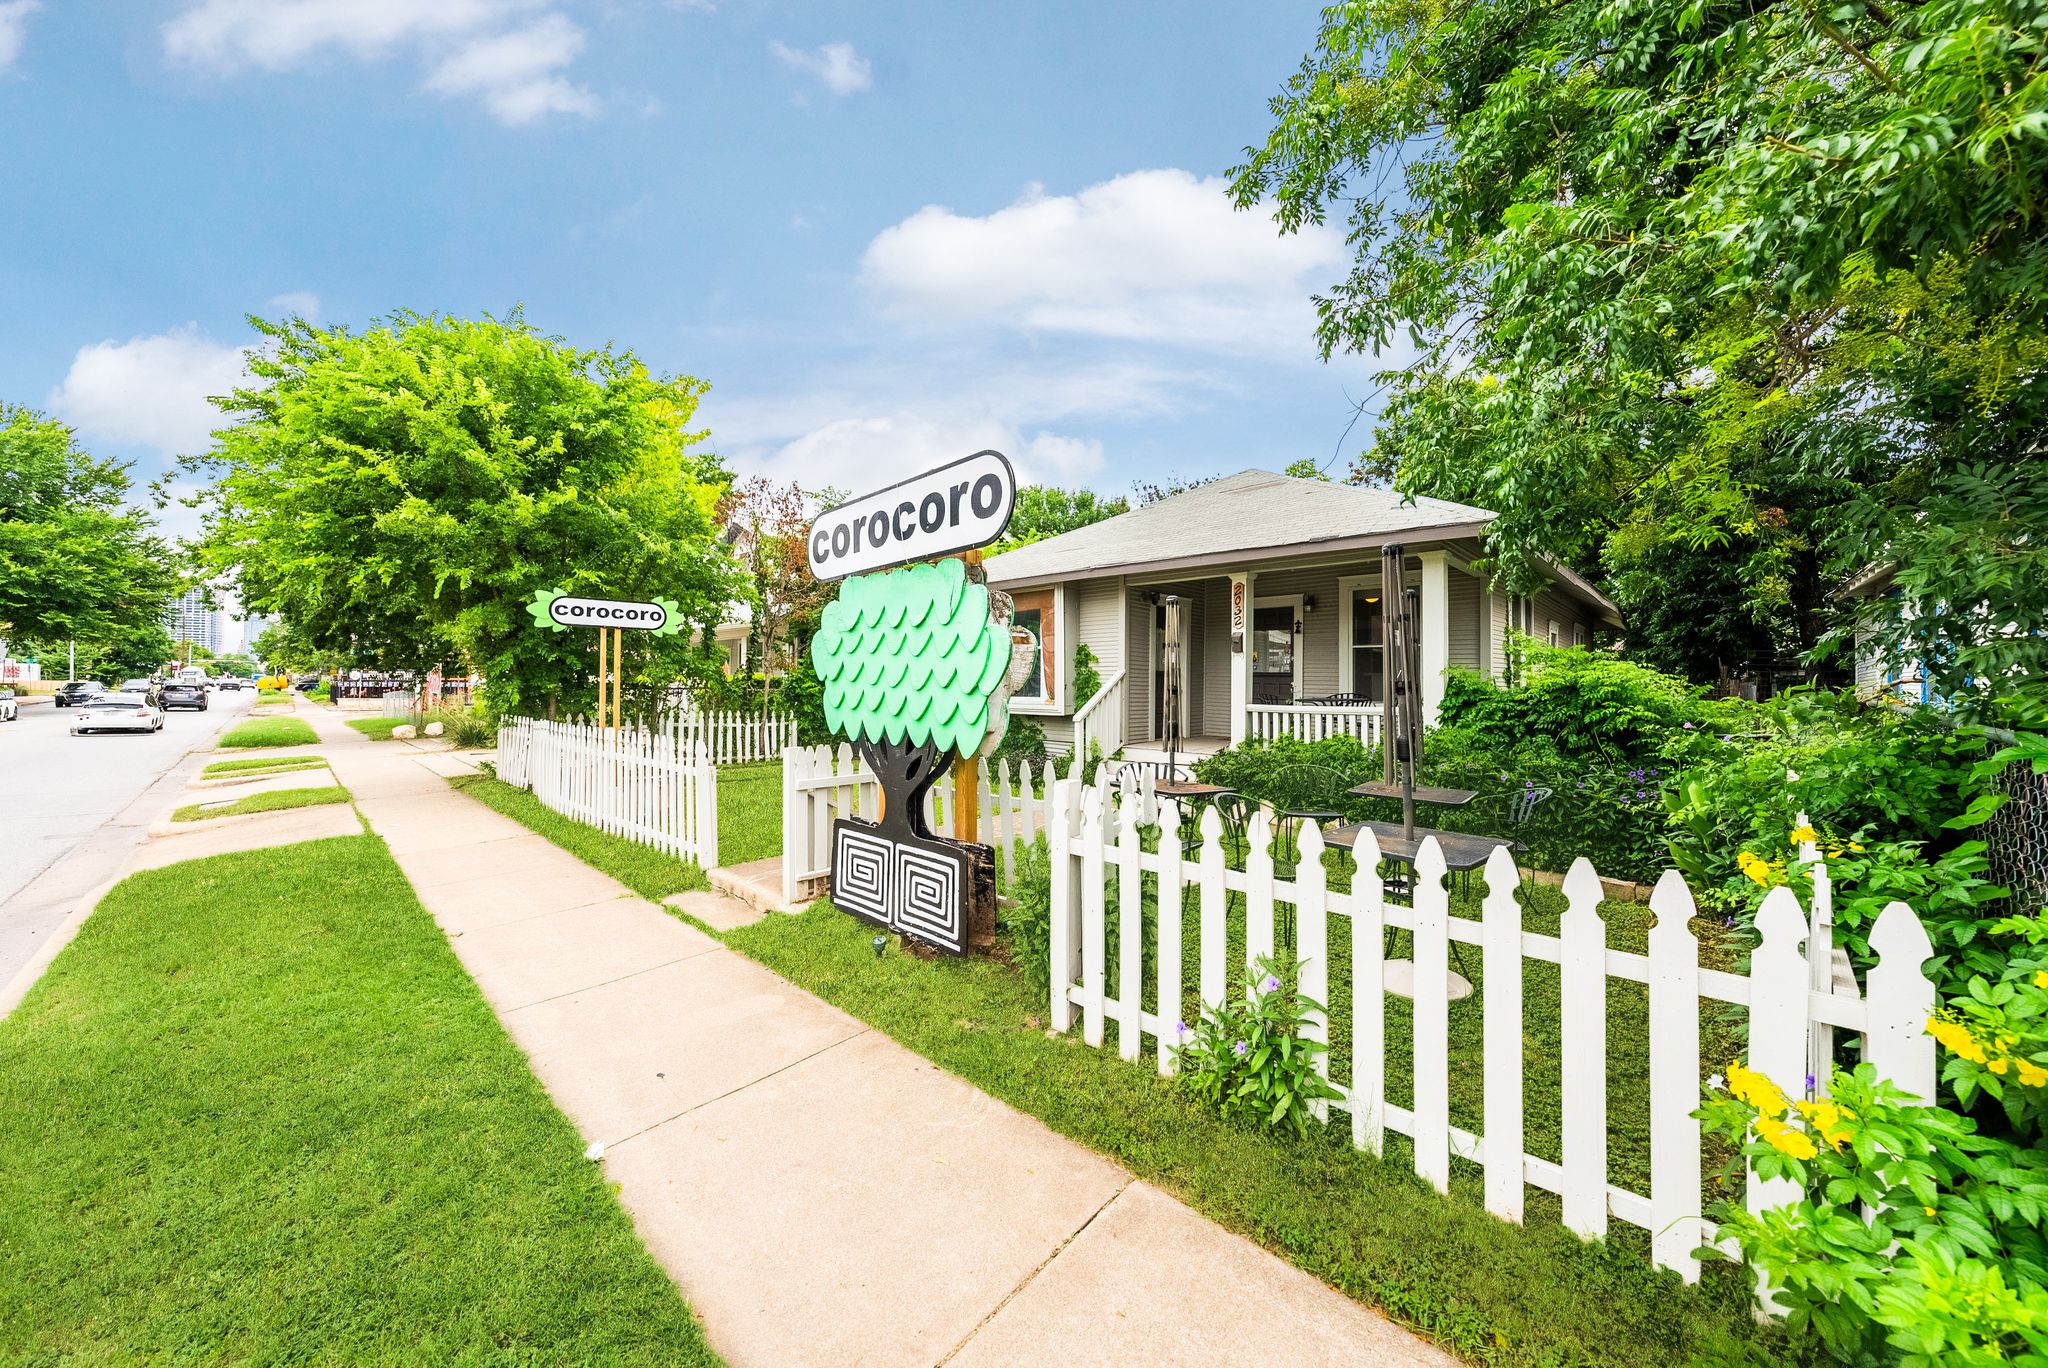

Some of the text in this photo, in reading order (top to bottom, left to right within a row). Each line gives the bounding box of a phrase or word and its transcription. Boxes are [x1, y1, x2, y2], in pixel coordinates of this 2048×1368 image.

[812, 473, 1003, 564] corocoro
[554, 604, 662, 622] corocoro
[1233, 585, 1242, 626] 2032
